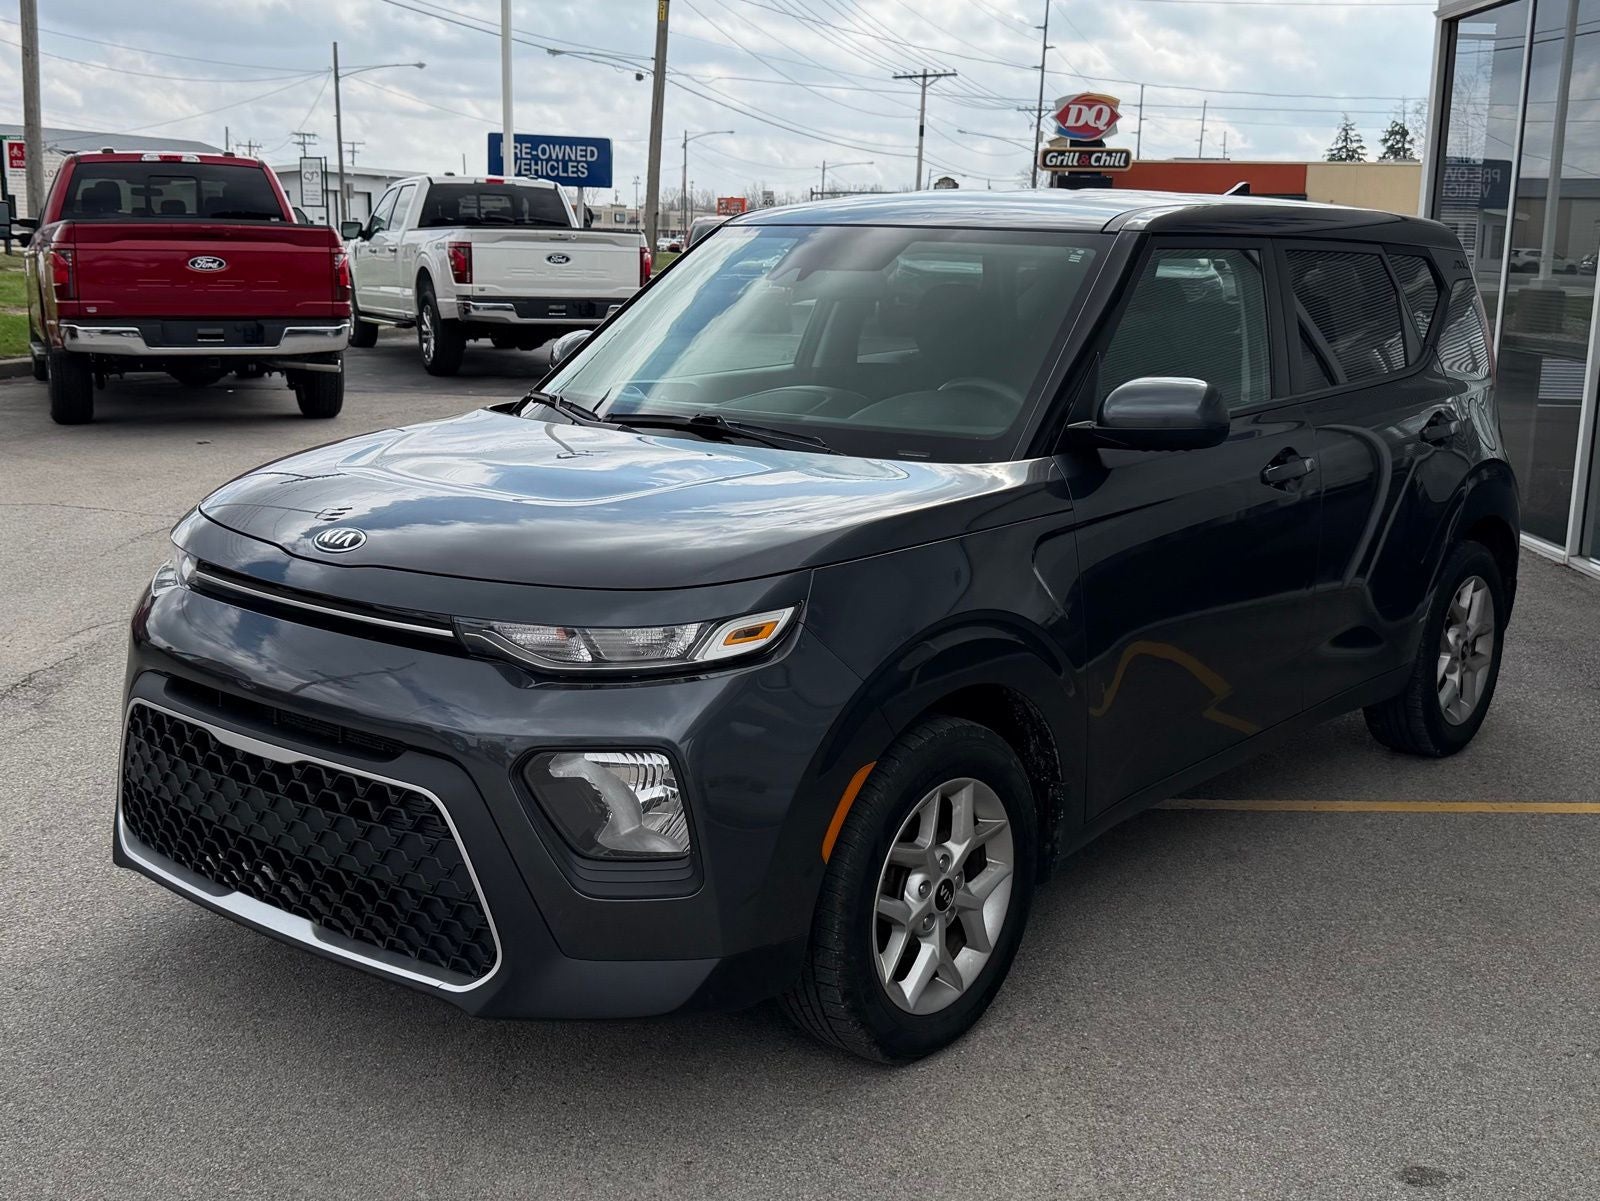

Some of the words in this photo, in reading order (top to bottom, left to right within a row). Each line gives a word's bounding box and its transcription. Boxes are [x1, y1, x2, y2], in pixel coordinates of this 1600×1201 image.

[1065, 104, 1111, 130] DQ
[500, 142, 598, 161] RE-OWNED
[1045, 152, 1079, 166] Grill
[1090, 153, 1127, 167] Chill
[195, 257, 220, 269] Ford
[318, 529, 357, 547] KIA
